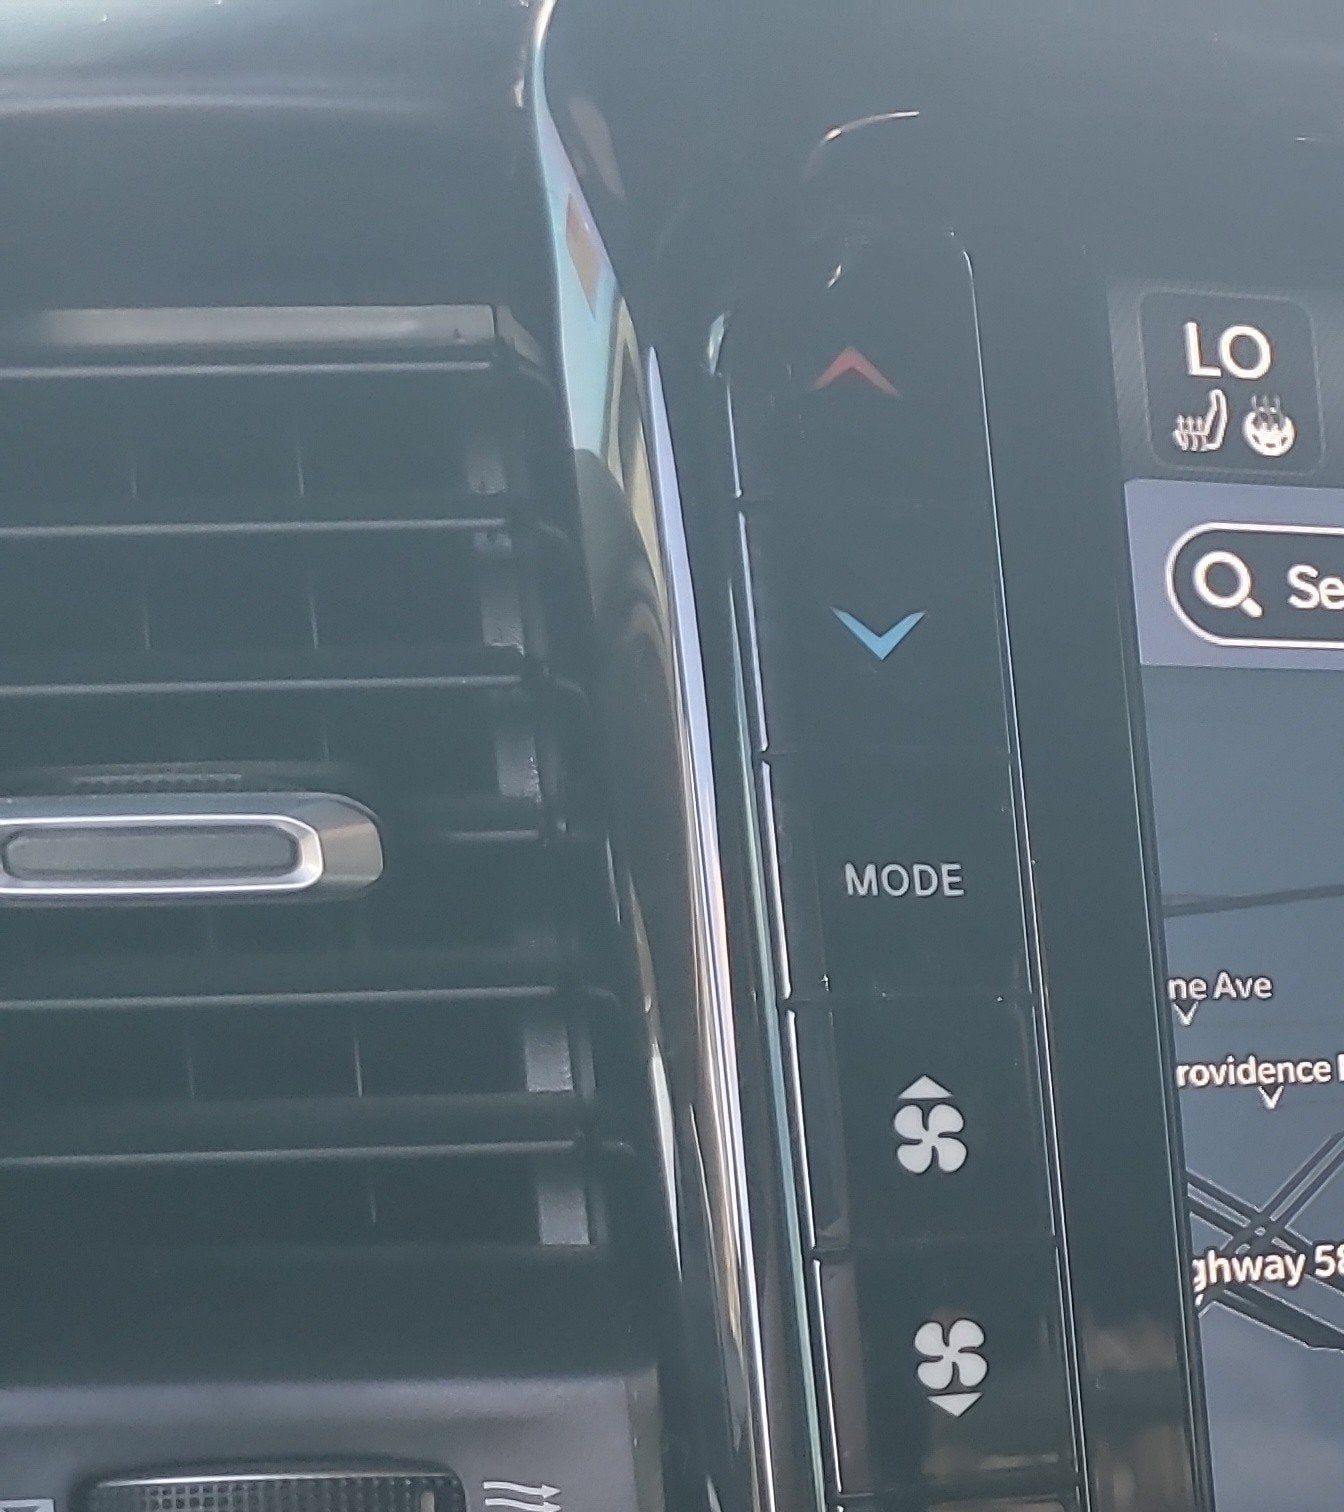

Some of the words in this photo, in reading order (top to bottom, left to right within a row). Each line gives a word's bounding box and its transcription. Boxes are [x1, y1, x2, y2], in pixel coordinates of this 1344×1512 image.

[1184, 322, 1272, 379] LO
[845, 863, 965, 897] MODE
[1168, 977, 1207, 1000] ne
[1213, 971, 1273, 1000] Ave
[1176, 1055, 1332, 1088] rovidence
